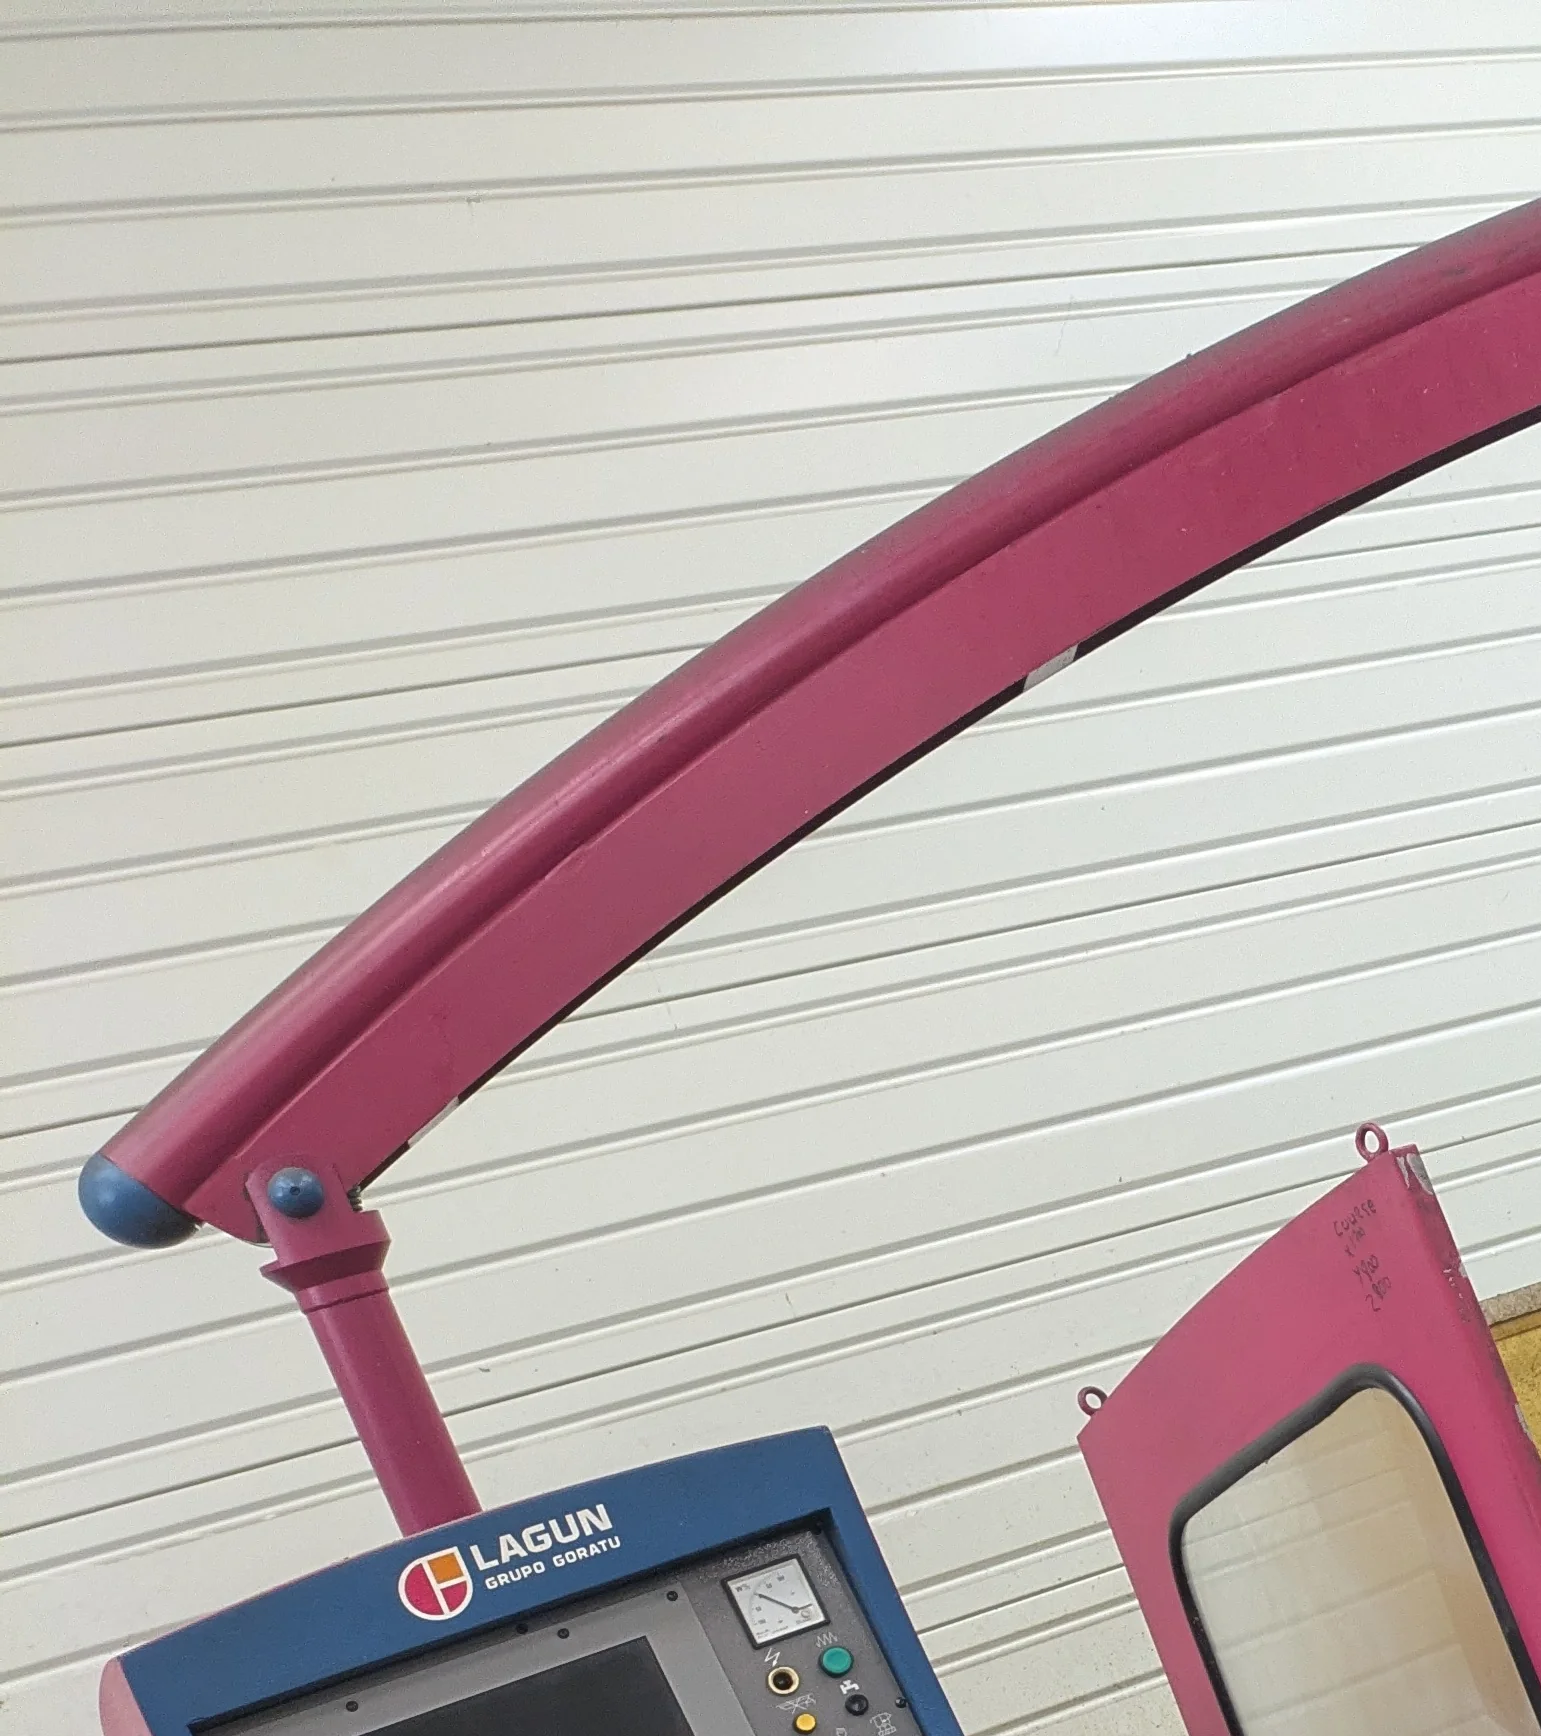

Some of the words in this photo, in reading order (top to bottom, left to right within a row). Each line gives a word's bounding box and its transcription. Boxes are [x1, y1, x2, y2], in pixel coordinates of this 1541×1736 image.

[470, 1503, 613, 1571] LAGUN
[485, 1561, 546, 1590] GRUPO
[552, 1535, 621, 1568] GORATU
